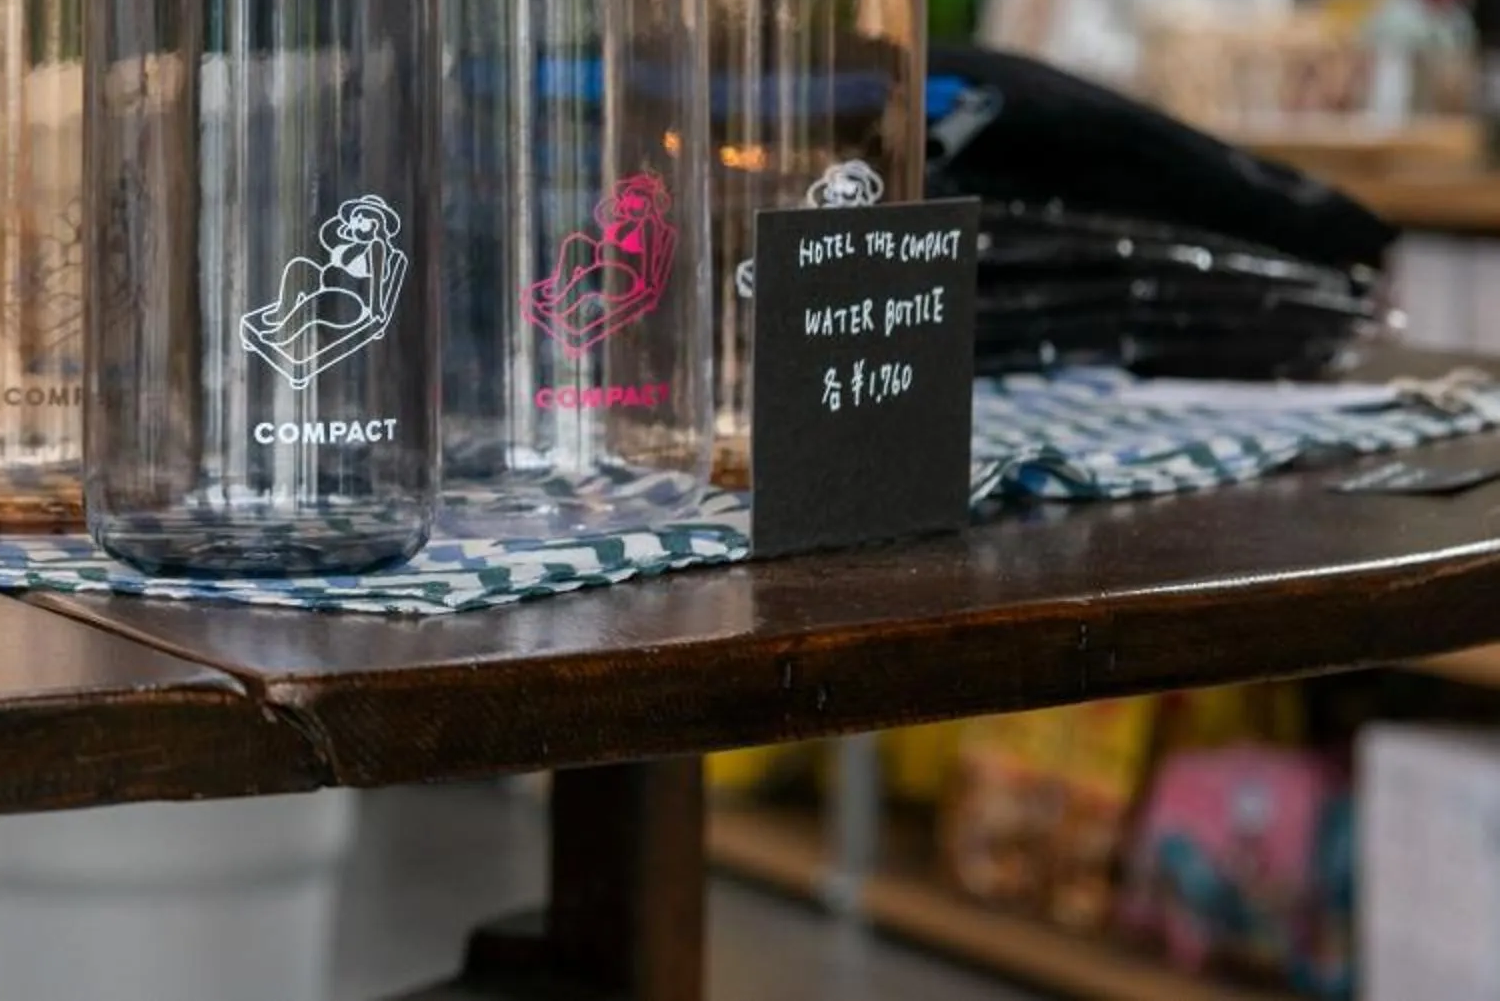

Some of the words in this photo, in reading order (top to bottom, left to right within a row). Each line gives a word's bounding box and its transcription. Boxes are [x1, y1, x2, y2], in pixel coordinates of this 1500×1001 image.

[799, 232, 855, 268] HOTEL
[865, 230, 896, 260] THE
[900, 228, 962, 263] COMPACT
[804, 298, 875, 336] WATER
[884, 286, 945, 337] BOTTLE
[535, 382, 670, 409] COMPACT
[253, 418, 397, 445] COMPACT
